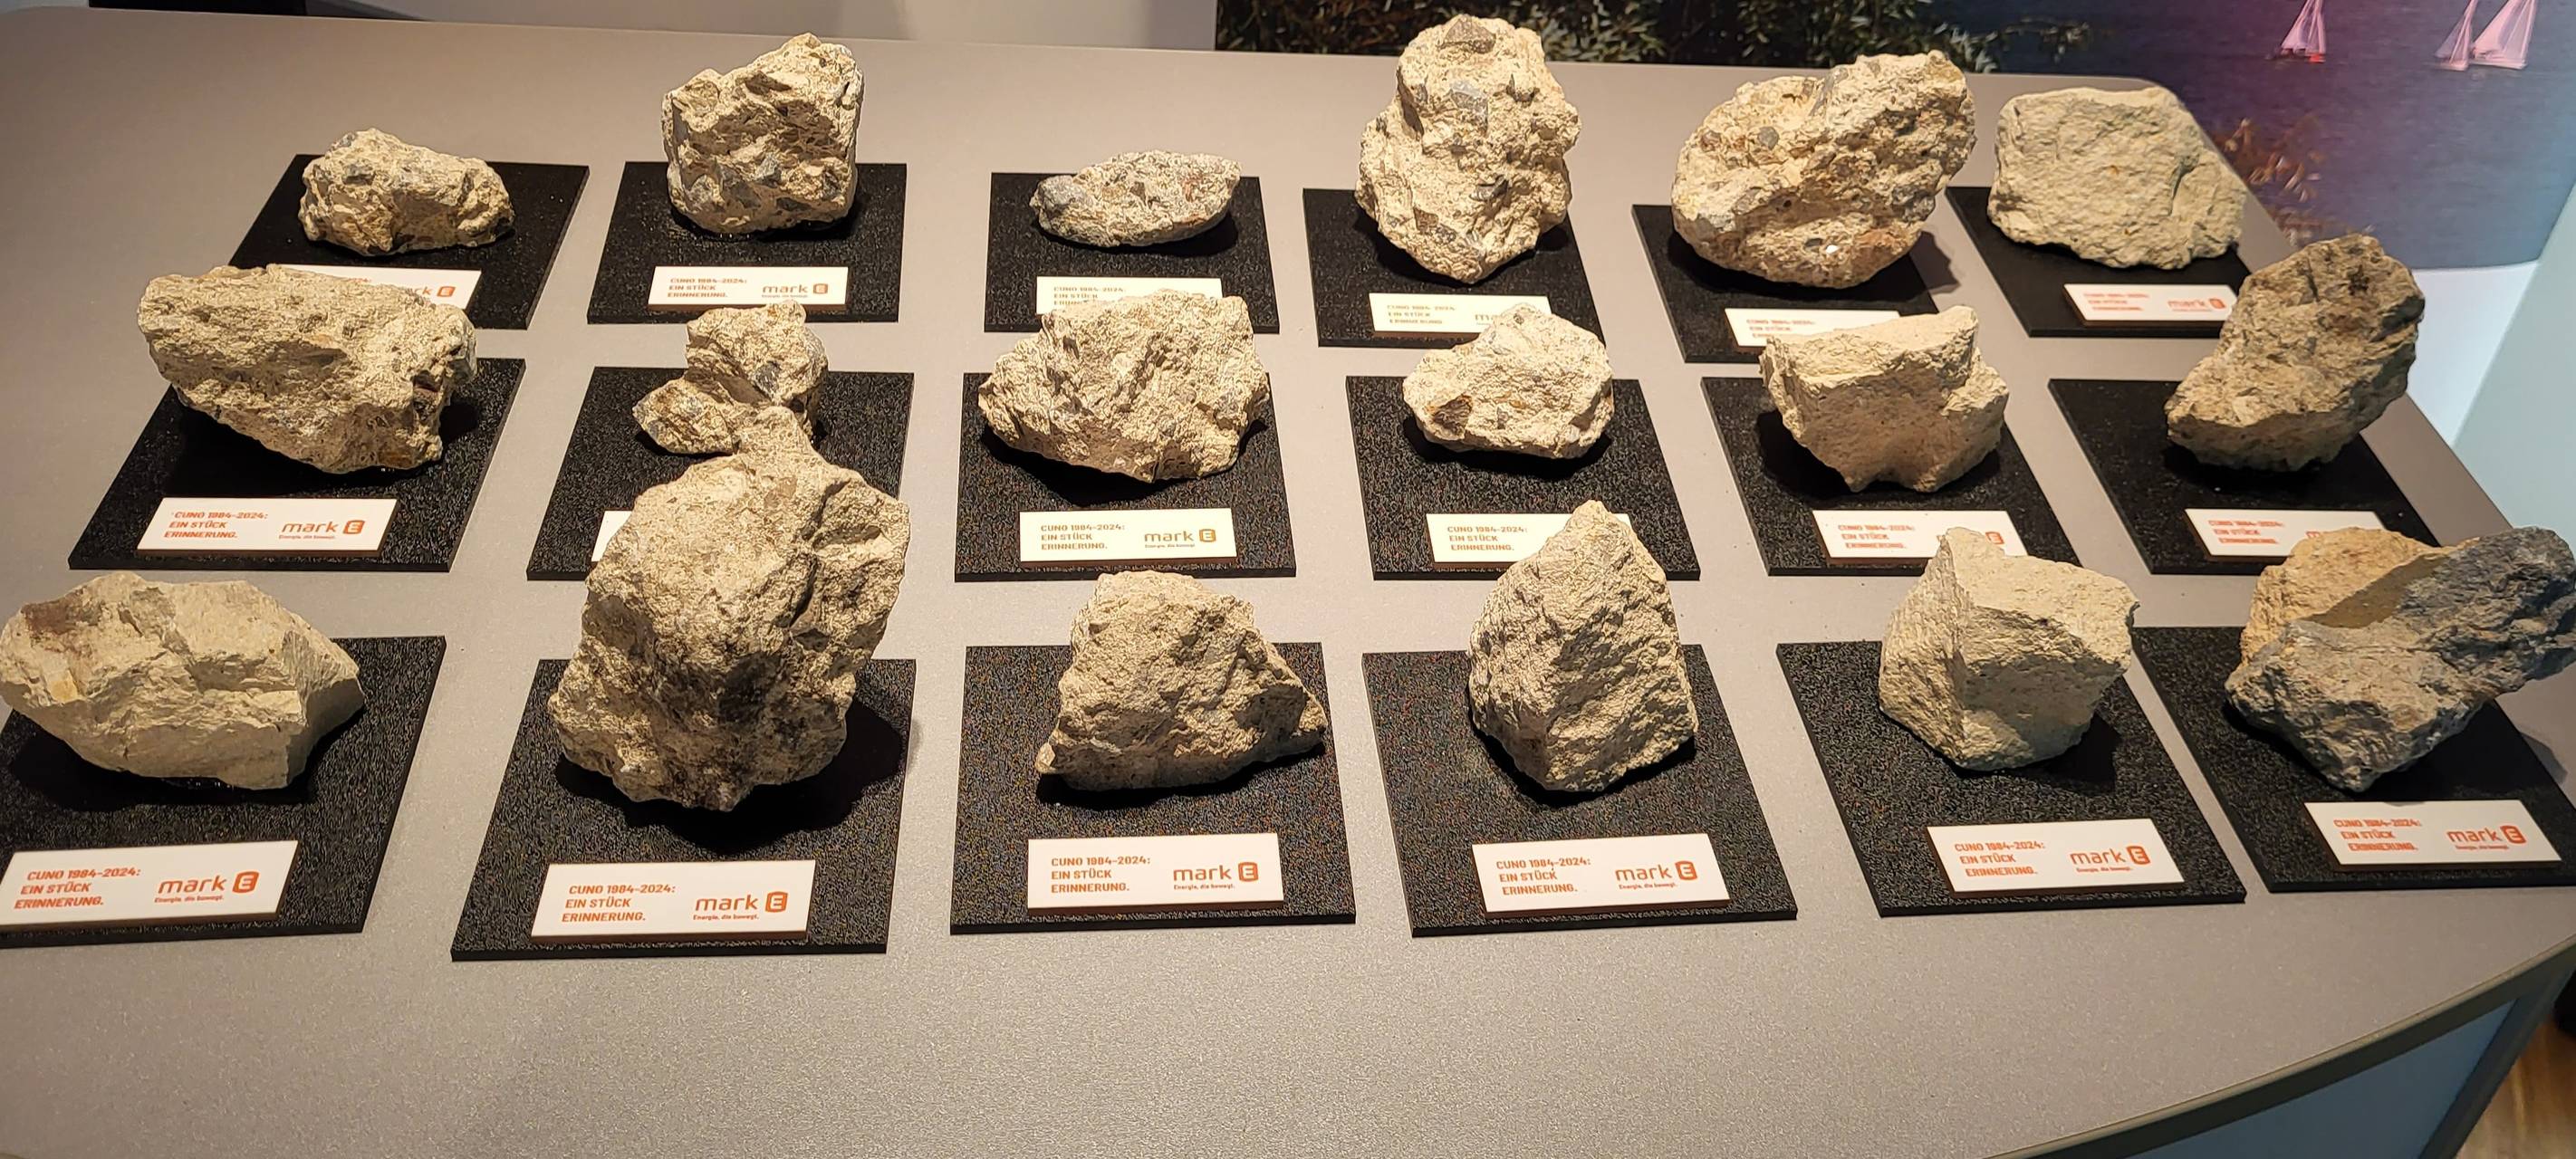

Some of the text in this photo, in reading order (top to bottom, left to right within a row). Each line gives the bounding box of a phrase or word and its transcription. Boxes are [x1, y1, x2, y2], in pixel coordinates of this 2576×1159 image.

[763, 284, 808, 292] mark
[282, 522, 338, 532] mark
[1145, 531, 1194, 541] mark
[2447, 828, 2503, 842] mark
[1955, 843, 1984, 852] CUNO
[1052, 856, 1151, 867] CUNO 1984-2024:
[1960, 853, 2015, 864] EIN STÜCK
[2070, 848, 2126, 864] mark
[1496, 860, 1526, 870] CUNO
[27, 867, 141, 881] CUNO 1984-2024:
[1052, 868, 1111, 880] EIN STÜCK
[1173, 865, 1232, 881] mark
[1500, 870, 1557, 883] EIN STÜCK
[1615, 864, 1672, 881] mark
[1966, 867, 2038, 876] ERINNERUNG.
[21, 882, 91, 895] EIN STÜCK
[159, 875, 226, 894] mark
[569, 884, 676, 894] CUNO 1984-2024:
[1051, 883, 1129, 893] ERINNERUNG.
[1503, 884, 1578, 896] ERINNERUNG.
[14, 896, 103, 909] ERINNERUNG.
[565, 897, 631, 908] EIN STÜCK
[696, 895, 758, 911] mark
[562, 912, 646, 922] ERINNERUNG.
